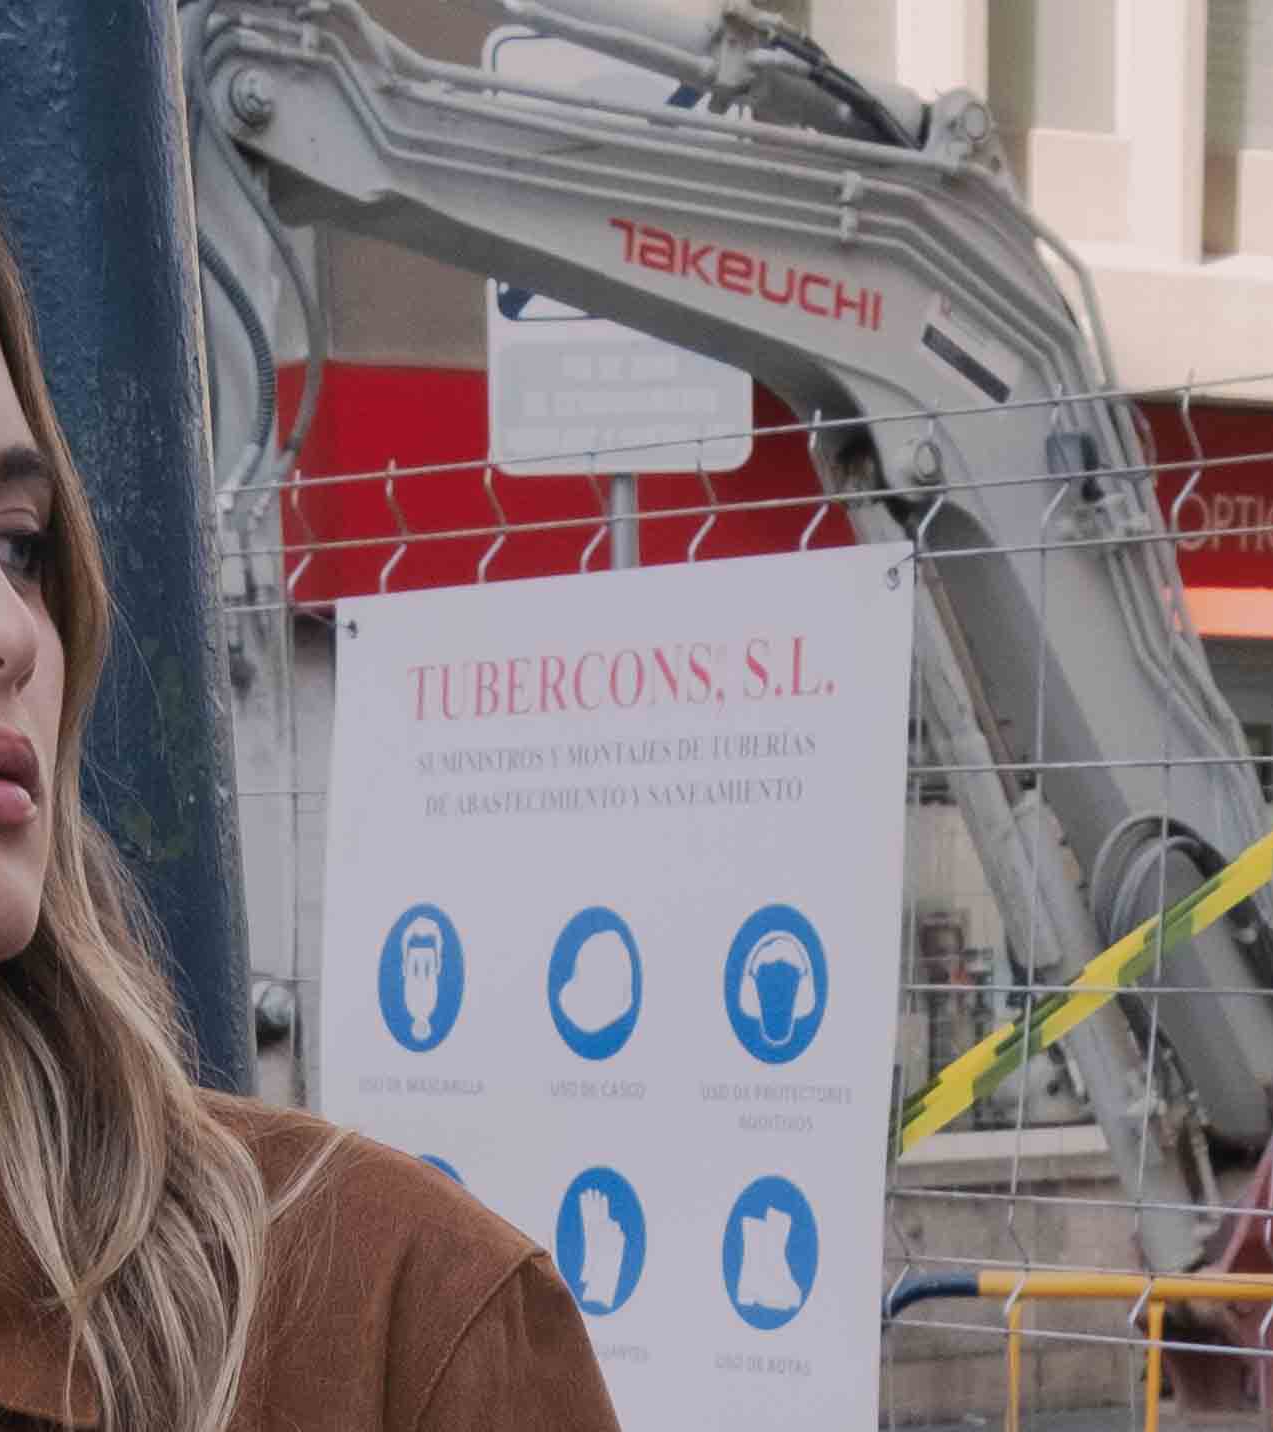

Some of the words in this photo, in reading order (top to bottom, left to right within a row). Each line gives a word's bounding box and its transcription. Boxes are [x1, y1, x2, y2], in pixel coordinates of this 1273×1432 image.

[608, 217, 882, 331] TAKEUCHI
[407, 642, 725, 721] TUBERCONS,
[743, 635, 836, 701] S.L.
[678, 735, 703, 761] DE
